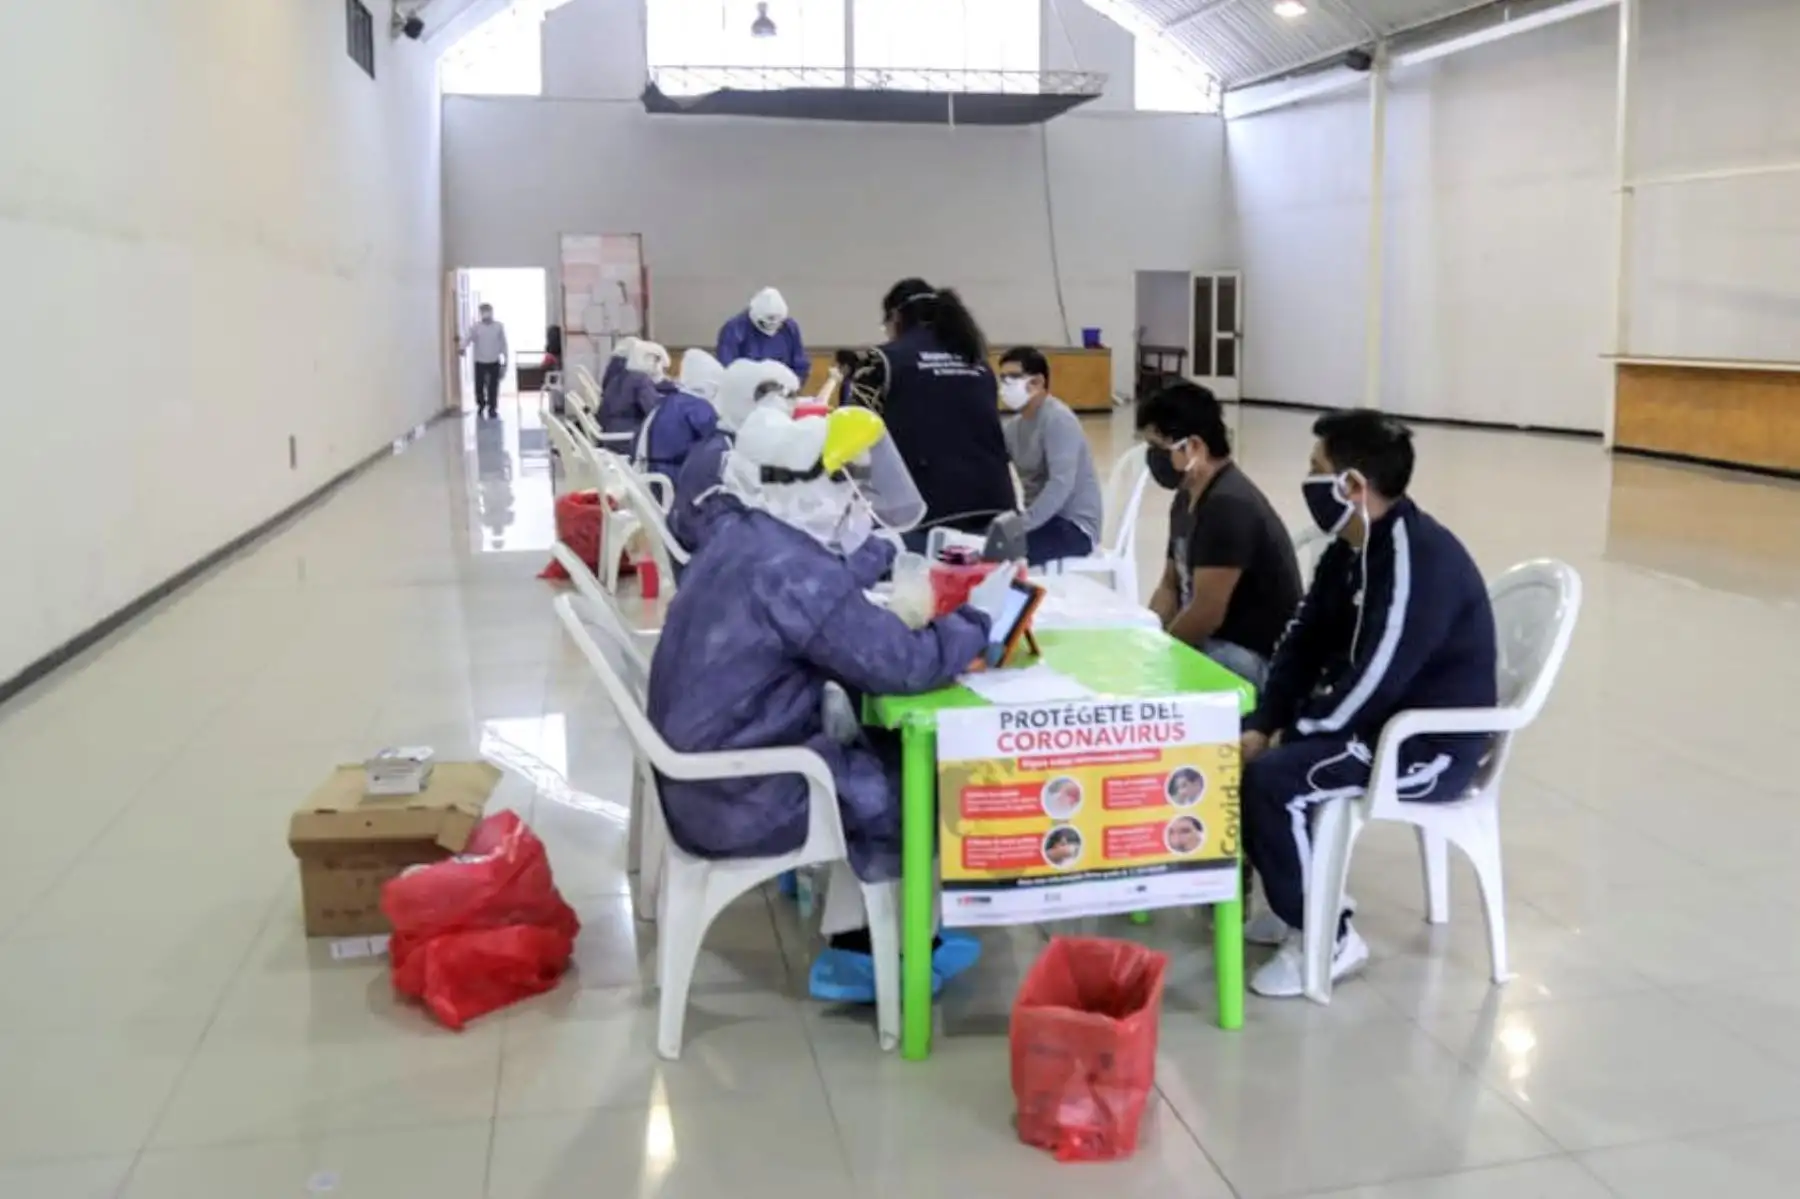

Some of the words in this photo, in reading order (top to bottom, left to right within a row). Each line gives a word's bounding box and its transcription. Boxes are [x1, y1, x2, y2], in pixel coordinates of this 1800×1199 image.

[1000, 704, 1133, 729] PROTÉGETE
[1140, 701, 1184, 720] DEL
[997, 722, 1186, 752] CORONAVIRUS
[1218, 743, 1238, 857] Covid-19
